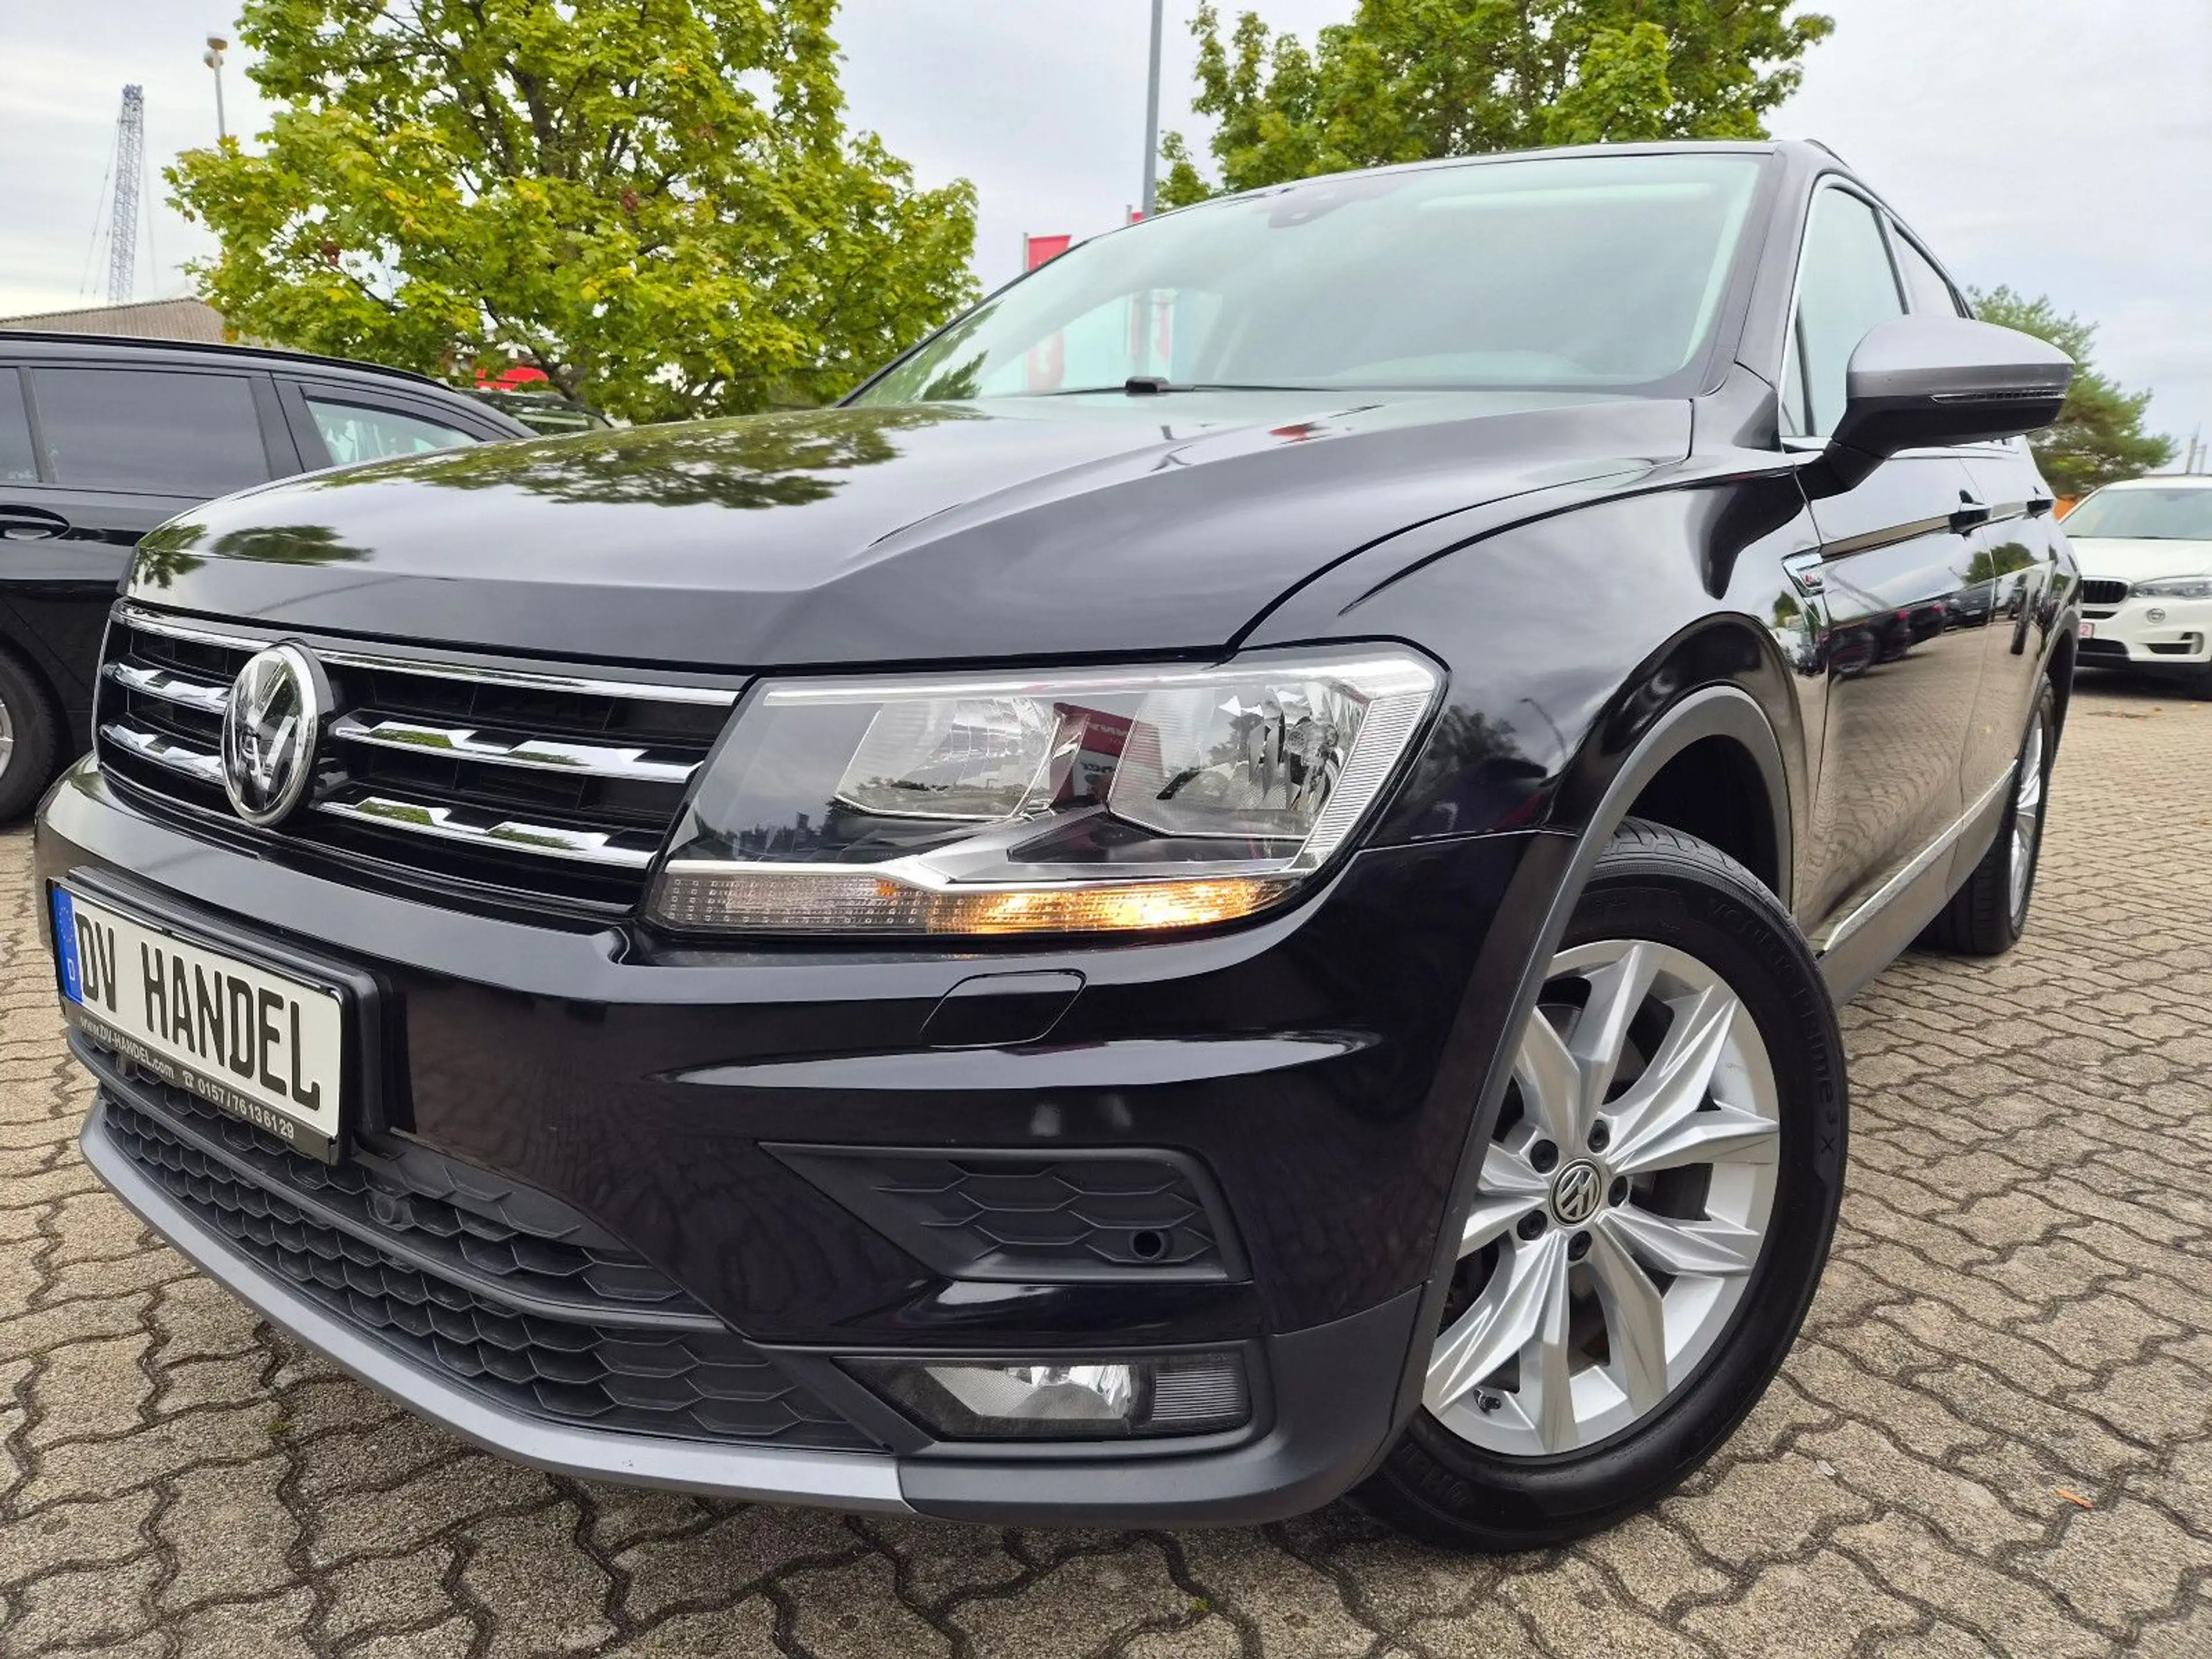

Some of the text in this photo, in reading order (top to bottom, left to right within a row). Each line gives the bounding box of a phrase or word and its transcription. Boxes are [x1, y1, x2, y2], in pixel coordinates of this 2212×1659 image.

[66, 957, 76, 981] D
[75, 911, 320, 1111] DV HANDEL
